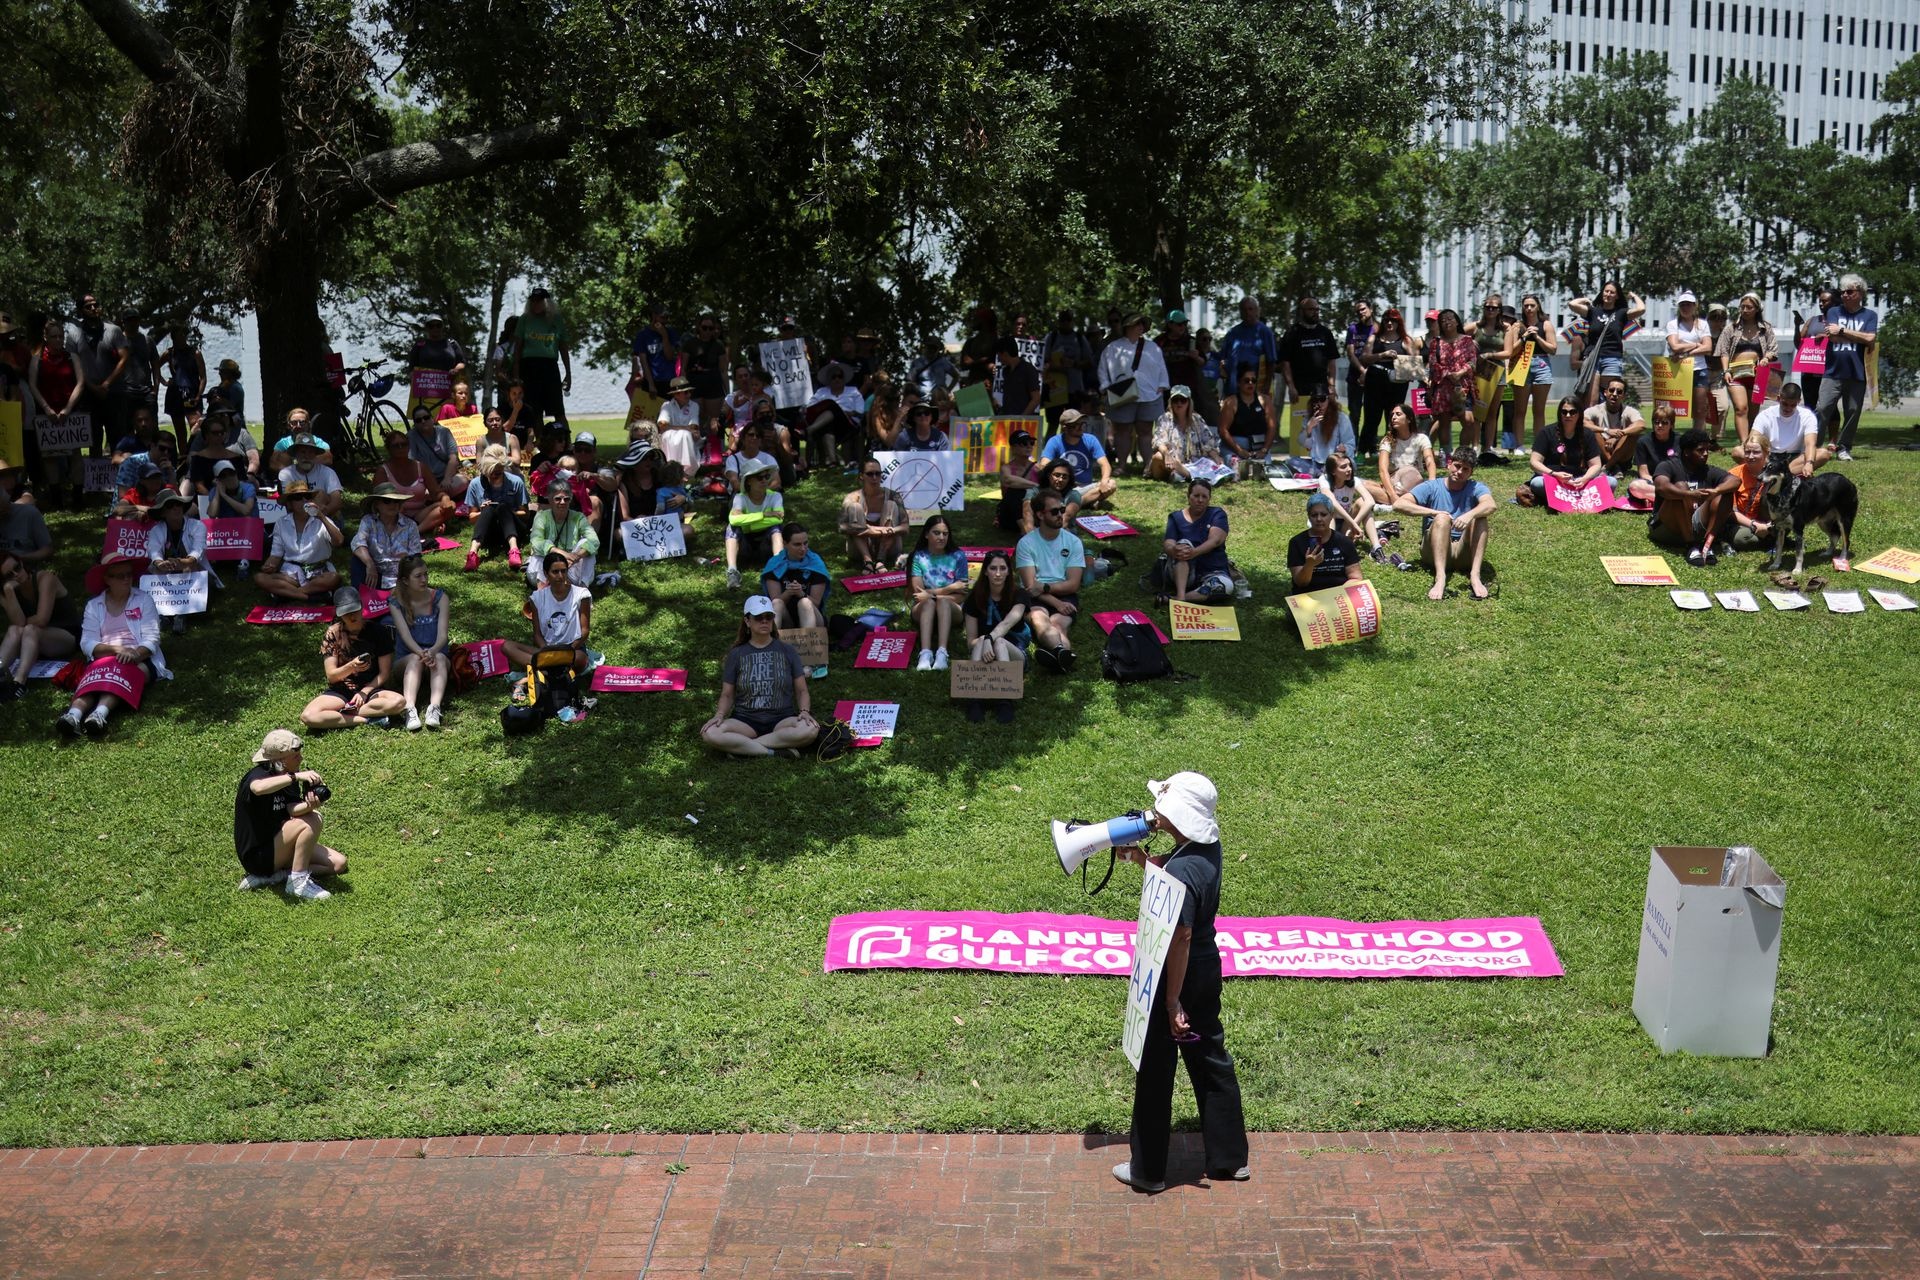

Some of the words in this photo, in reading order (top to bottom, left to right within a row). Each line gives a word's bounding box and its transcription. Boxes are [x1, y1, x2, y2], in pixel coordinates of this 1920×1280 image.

[764, 349, 780, 360] WE
[782, 346, 801, 356] WILL
[1019, 340, 1045, 354] TECT
[766, 358, 802, 372] NOT
[785, 370, 807, 384] BACK
[37, 421, 48, 430] WE
[68, 416, 86, 426] NOT
[41, 428, 90, 446] ASKING
[92, 472, 110, 485] HER
[880, 459, 900, 484] EVER
[938, 478, 962, 509] AGAIN!
[260, 502, 286, 512] ION
[206, 530, 230, 538] ortion
[232, 529, 239, 537] is
[630, 517, 674, 540] DEFEND
[118, 538, 142, 548] OFF
[206, 537, 224, 546] alth
[226, 537, 252, 546] Care.
[117, 548, 149, 558] BOD
[1174, 604, 1212, 616] STOP.
[1174, 614, 1206, 622] THE.
[1356, 608, 1368, 634] FEWER
[1307, 622, 1322, 645] MORE
[1332, 616, 1346, 641] MORE
[866, 638, 881, 660] BODIES
[892, 638, 906, 653] BANS
[750, 651, 774, 664] THESE
[750, 662, 774, 681] ARE
[970, 664, 988, 672] claim
[104, 672, 132, 690] Care.
[750, 680, 774, 696] DARK
[1143, 873, 1180, 924] MEN
[928, 924, 1136, 946] PLANNE
[1216, 930, 1524, 949] ARENTHOOD
[925, 944, 1049, 966] GULF
[1242, 952, 1522, 966] WWW.PPGULFCOAST.ORG
